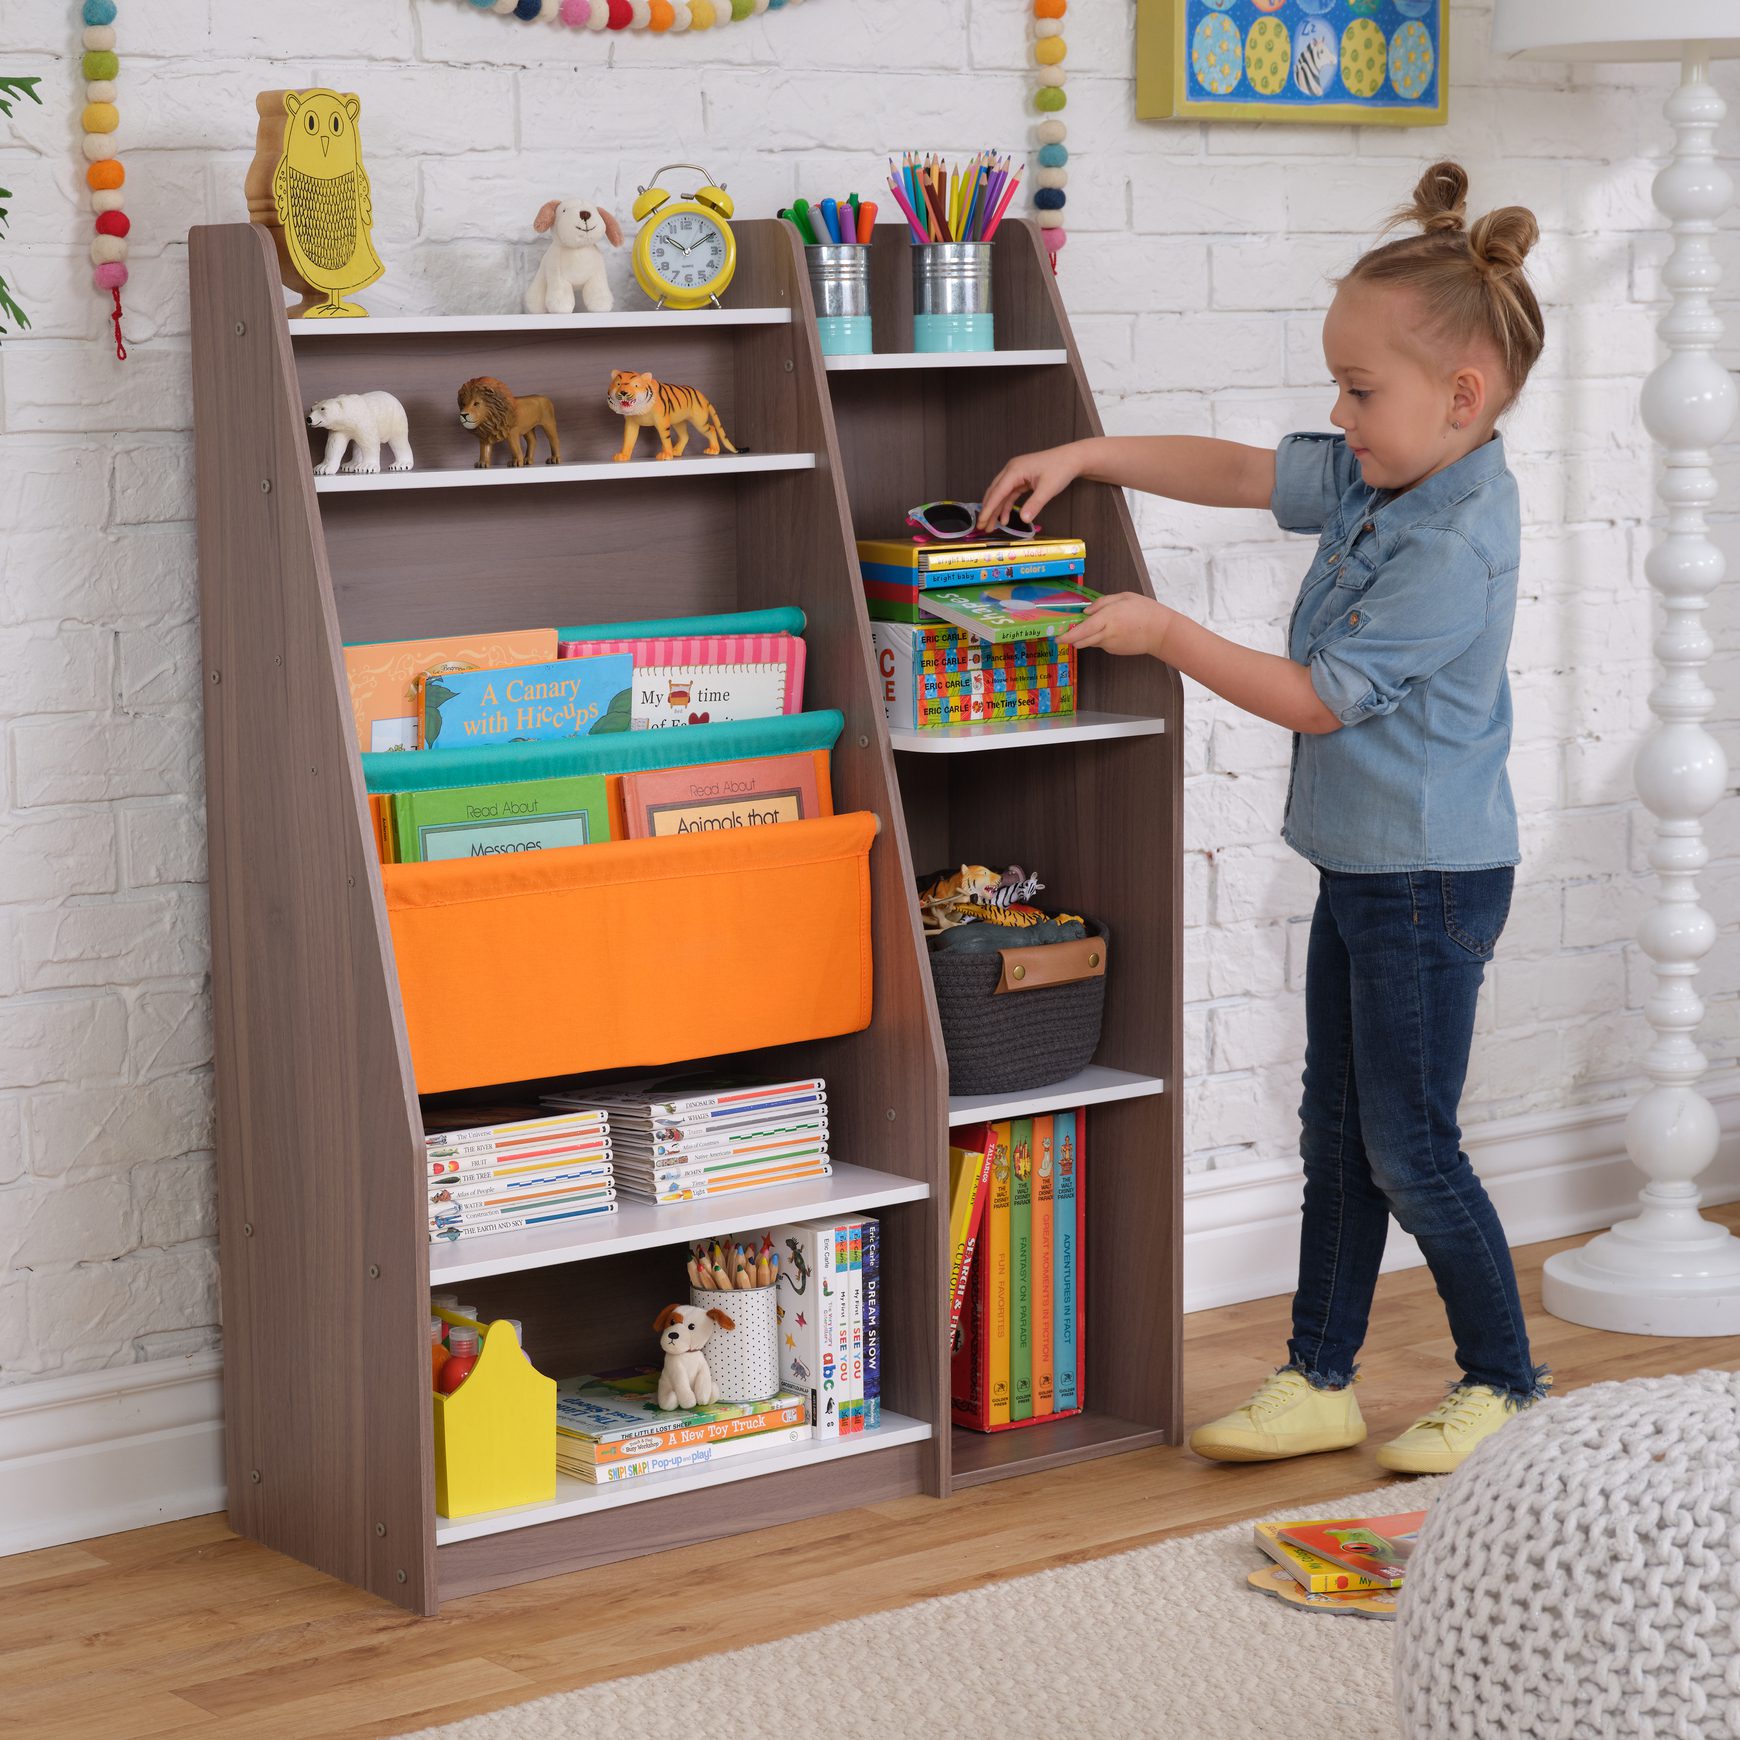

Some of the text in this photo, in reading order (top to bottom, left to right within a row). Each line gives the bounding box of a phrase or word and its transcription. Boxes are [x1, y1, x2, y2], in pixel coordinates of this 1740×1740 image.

[670, 225, 677, 234] 11
[680, 221, 692, 230] 12
[656, 248, 664, 257] 9
[711, 246, 718, 255] 3
[661, 262, 670, 271] 8
[706, 260, 714, 269] 4
[672, 270, 680, 279] 7
[684, 274, 693, 283] 6
[698, 270, 706, 279] 5
[933, 572, 955, 582] bright
[958, 572, 974, 580] baby
[922, 632, 967, 644] ERIC CARLE
[1002, 631, 1023, 639] bright
[921, 658, 939, 667] ERIC
[942, 657, 966, 666] CARLE
[925, 681, 943, 691] ERIC
[945, 679, 970, 688] CARLE
[480, 680, 581, 706] A Canary
[641, 688, 730, 707] My time
[924, 698, 1035, 715] ERIC CARLE The Tiny Seed
[464, 702, 599, 736] with Hiccups
[690, 780, 756, 797] Read About
[467, 799, 539, 818] Read About
[678, 809, 780, 834] Animals that
[470, 840, 542, 857] Messages
[685, 1100, 716, 1110] DINOSAURS
[688, 1113, 709, 1121] WHALES
[468, 1130, 491, 1139] Universe
[471, 1159, 487, 1167] FRUIT
[982, 1144, 995, 1183] TALLARICO
[476, 1172, 492, 1180] TREE
[476, 1187, 495, 1196] People
[466, 1210, 499, 1220] Construction
[477, 1225, 497, 1233] EARTH
[512, 1220, 523, 1228] SKY
[957, 1238, 975, 1295] SEARCH
[841, 1292, 845, 1300] My
[854, 1290, 859, 1298] My
[1020, 1286, 1027, 1301] ON
[868, 1282, 876, 1325] DREAM
[954, 1299, 962, 1310] &
[1042, 1307, 1049, 1319] IN
[1064, 1305, 1071, 1315] IN
[823, 1353, 836, 1391] abc
[635, 1429, 654, 1437] LITTLE
[656, 1425, 671, 1433] LOST
[668, 1433, 677, 1445] A
[681, 1429, 704, 1442] New
[708, 1425, 728, 1438] Toy
[732, 1415, 766, 1431] Truck
[608, 1467, 626, 1480] SNIP!
[628, 1461, 649, 1476] SNAP!
[652, 1456, 682, 1469] Pop-up
[692, 1448, 712, 1463] play!
[1359, 1577, 1371, 1586] My
